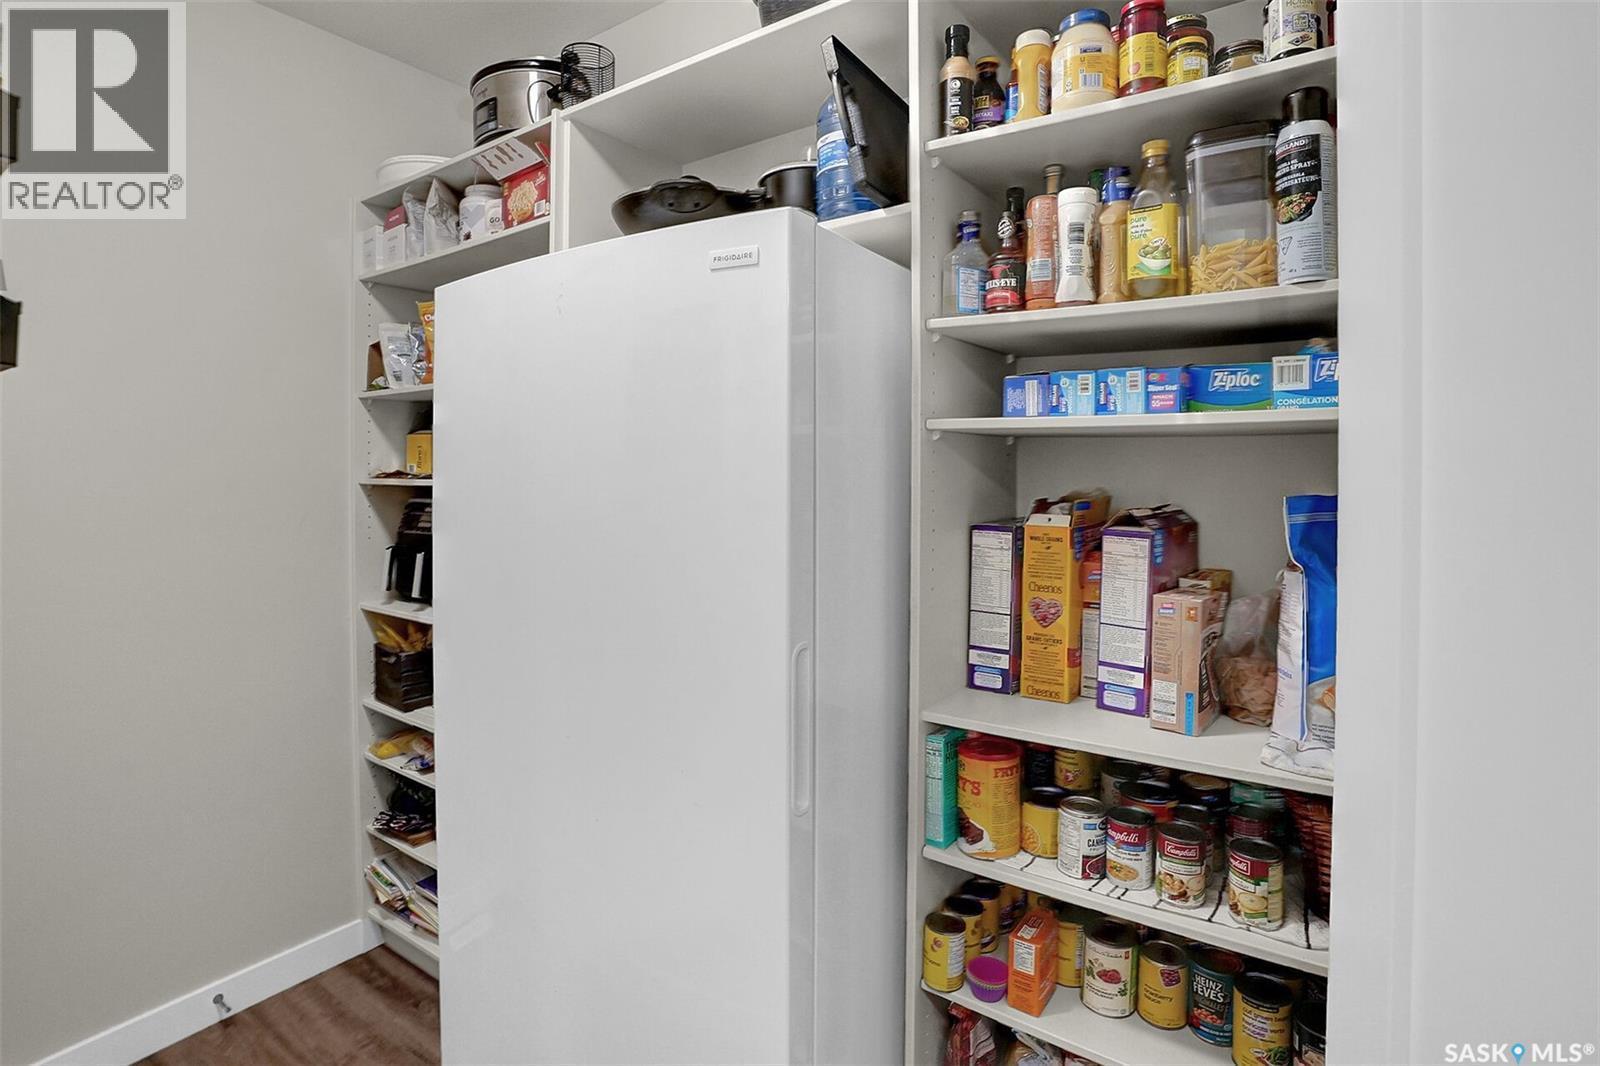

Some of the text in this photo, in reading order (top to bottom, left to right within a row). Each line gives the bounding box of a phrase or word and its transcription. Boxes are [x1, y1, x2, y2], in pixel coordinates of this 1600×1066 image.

[712, 251, 753, 263] FRIGIDAIRE
[1213, 369, 1261, 391] Ziploc
[1166, 844, 1197, 857] Campbell's
[1194, 973, 1223, 992] HEINZ
